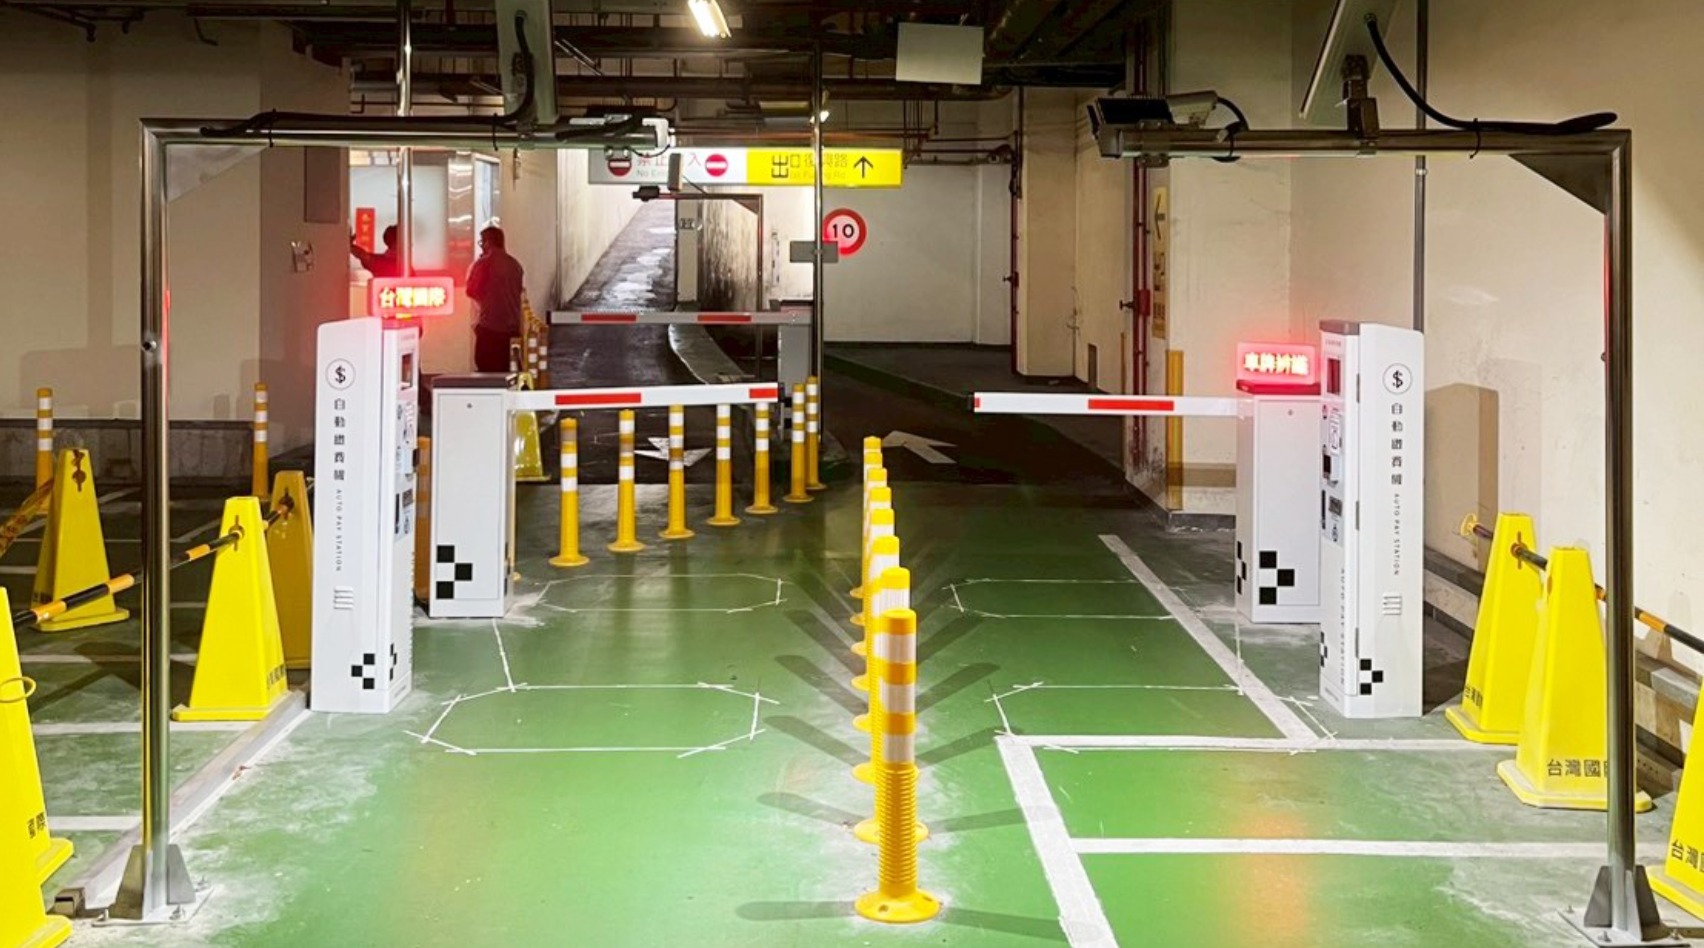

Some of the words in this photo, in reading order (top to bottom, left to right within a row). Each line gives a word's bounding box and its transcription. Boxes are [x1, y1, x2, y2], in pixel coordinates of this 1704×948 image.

[832, 223, 855, 239] 10
[335, 489, 343, 512] AUTO
[1393, 493, 1401, 516] AUTO
[335, 515, 343, 531] PAY
[1393, 519, 1401, 535] PAY
[335, 535, 343, 572] STATION
[1393, 538, 1401, 576] STATION
[1547, 758, 1608, 778] 台灣國
